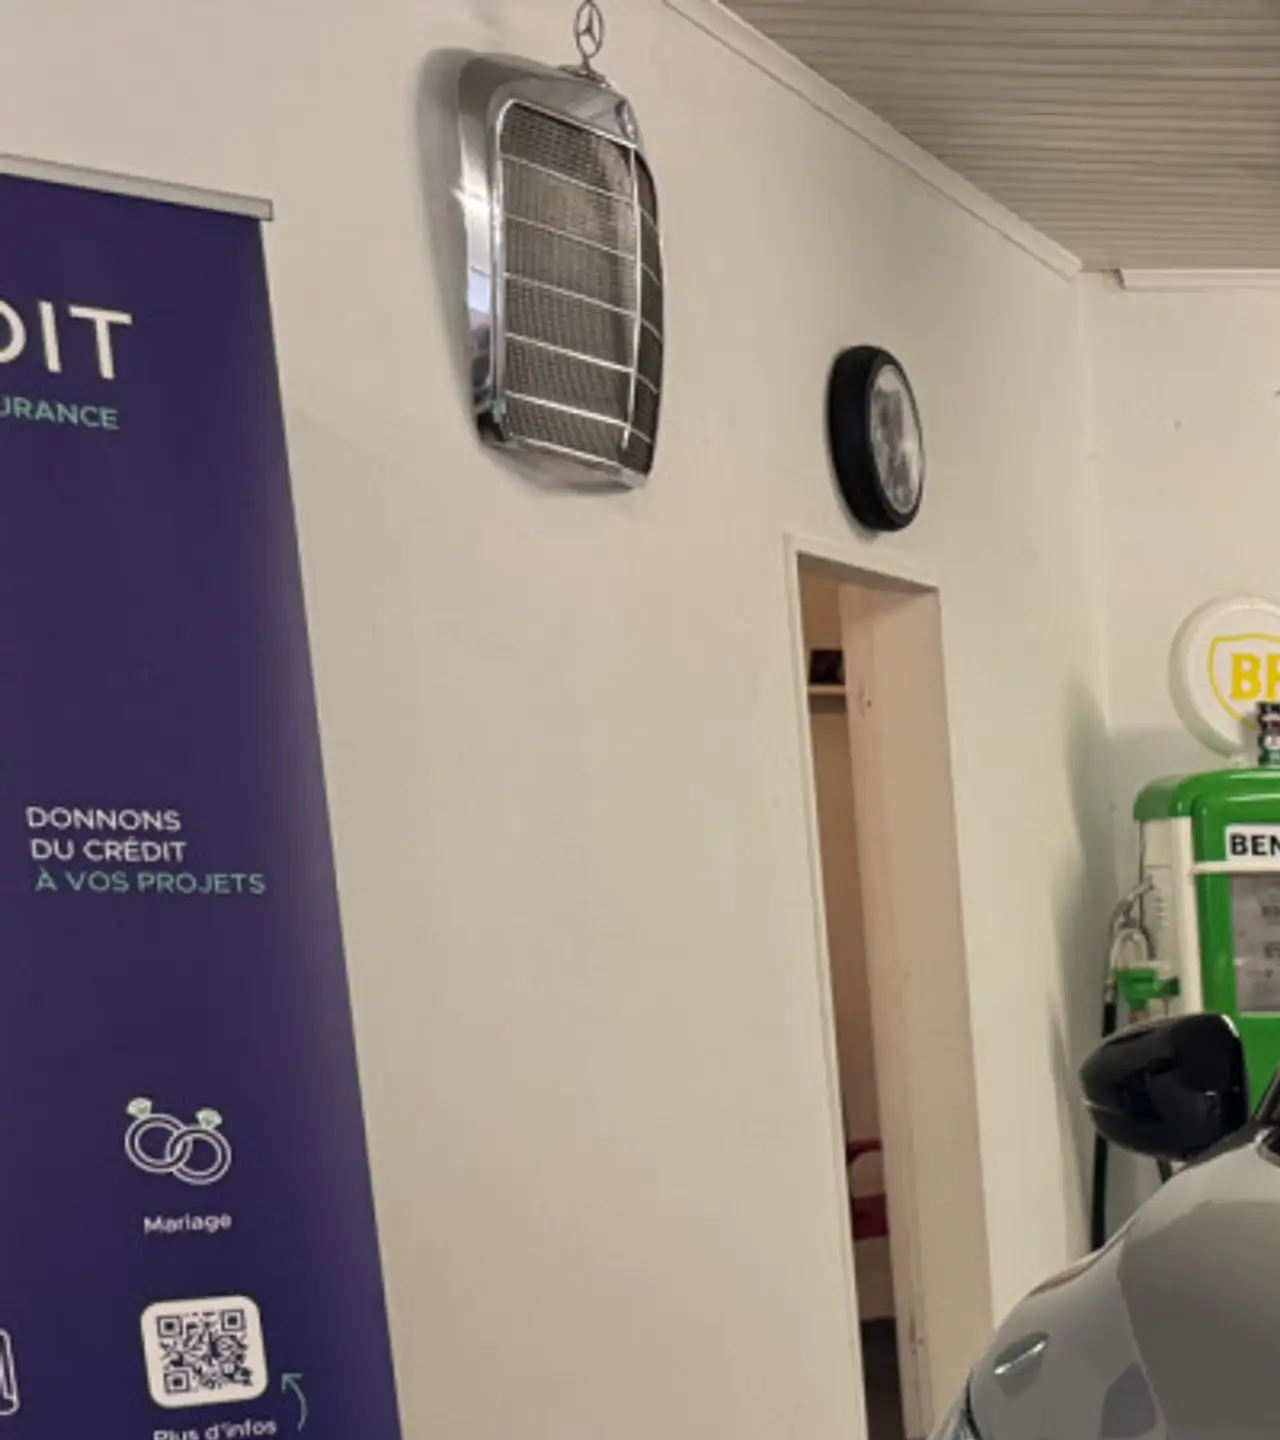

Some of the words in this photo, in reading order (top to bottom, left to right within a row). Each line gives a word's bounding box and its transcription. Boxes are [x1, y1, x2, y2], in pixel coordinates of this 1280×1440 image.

[25, 806, 182, 832] DONNONS
[30, 839, 75, 861] DU
[82, 836, 187, 863] CRÉDIT
[35, 865, 58, 892] À
[65, 870, 130, 893] VOS
[137, 872, 267, 895] PROJETS
[143, 1213, 232, 1235] Mariage
